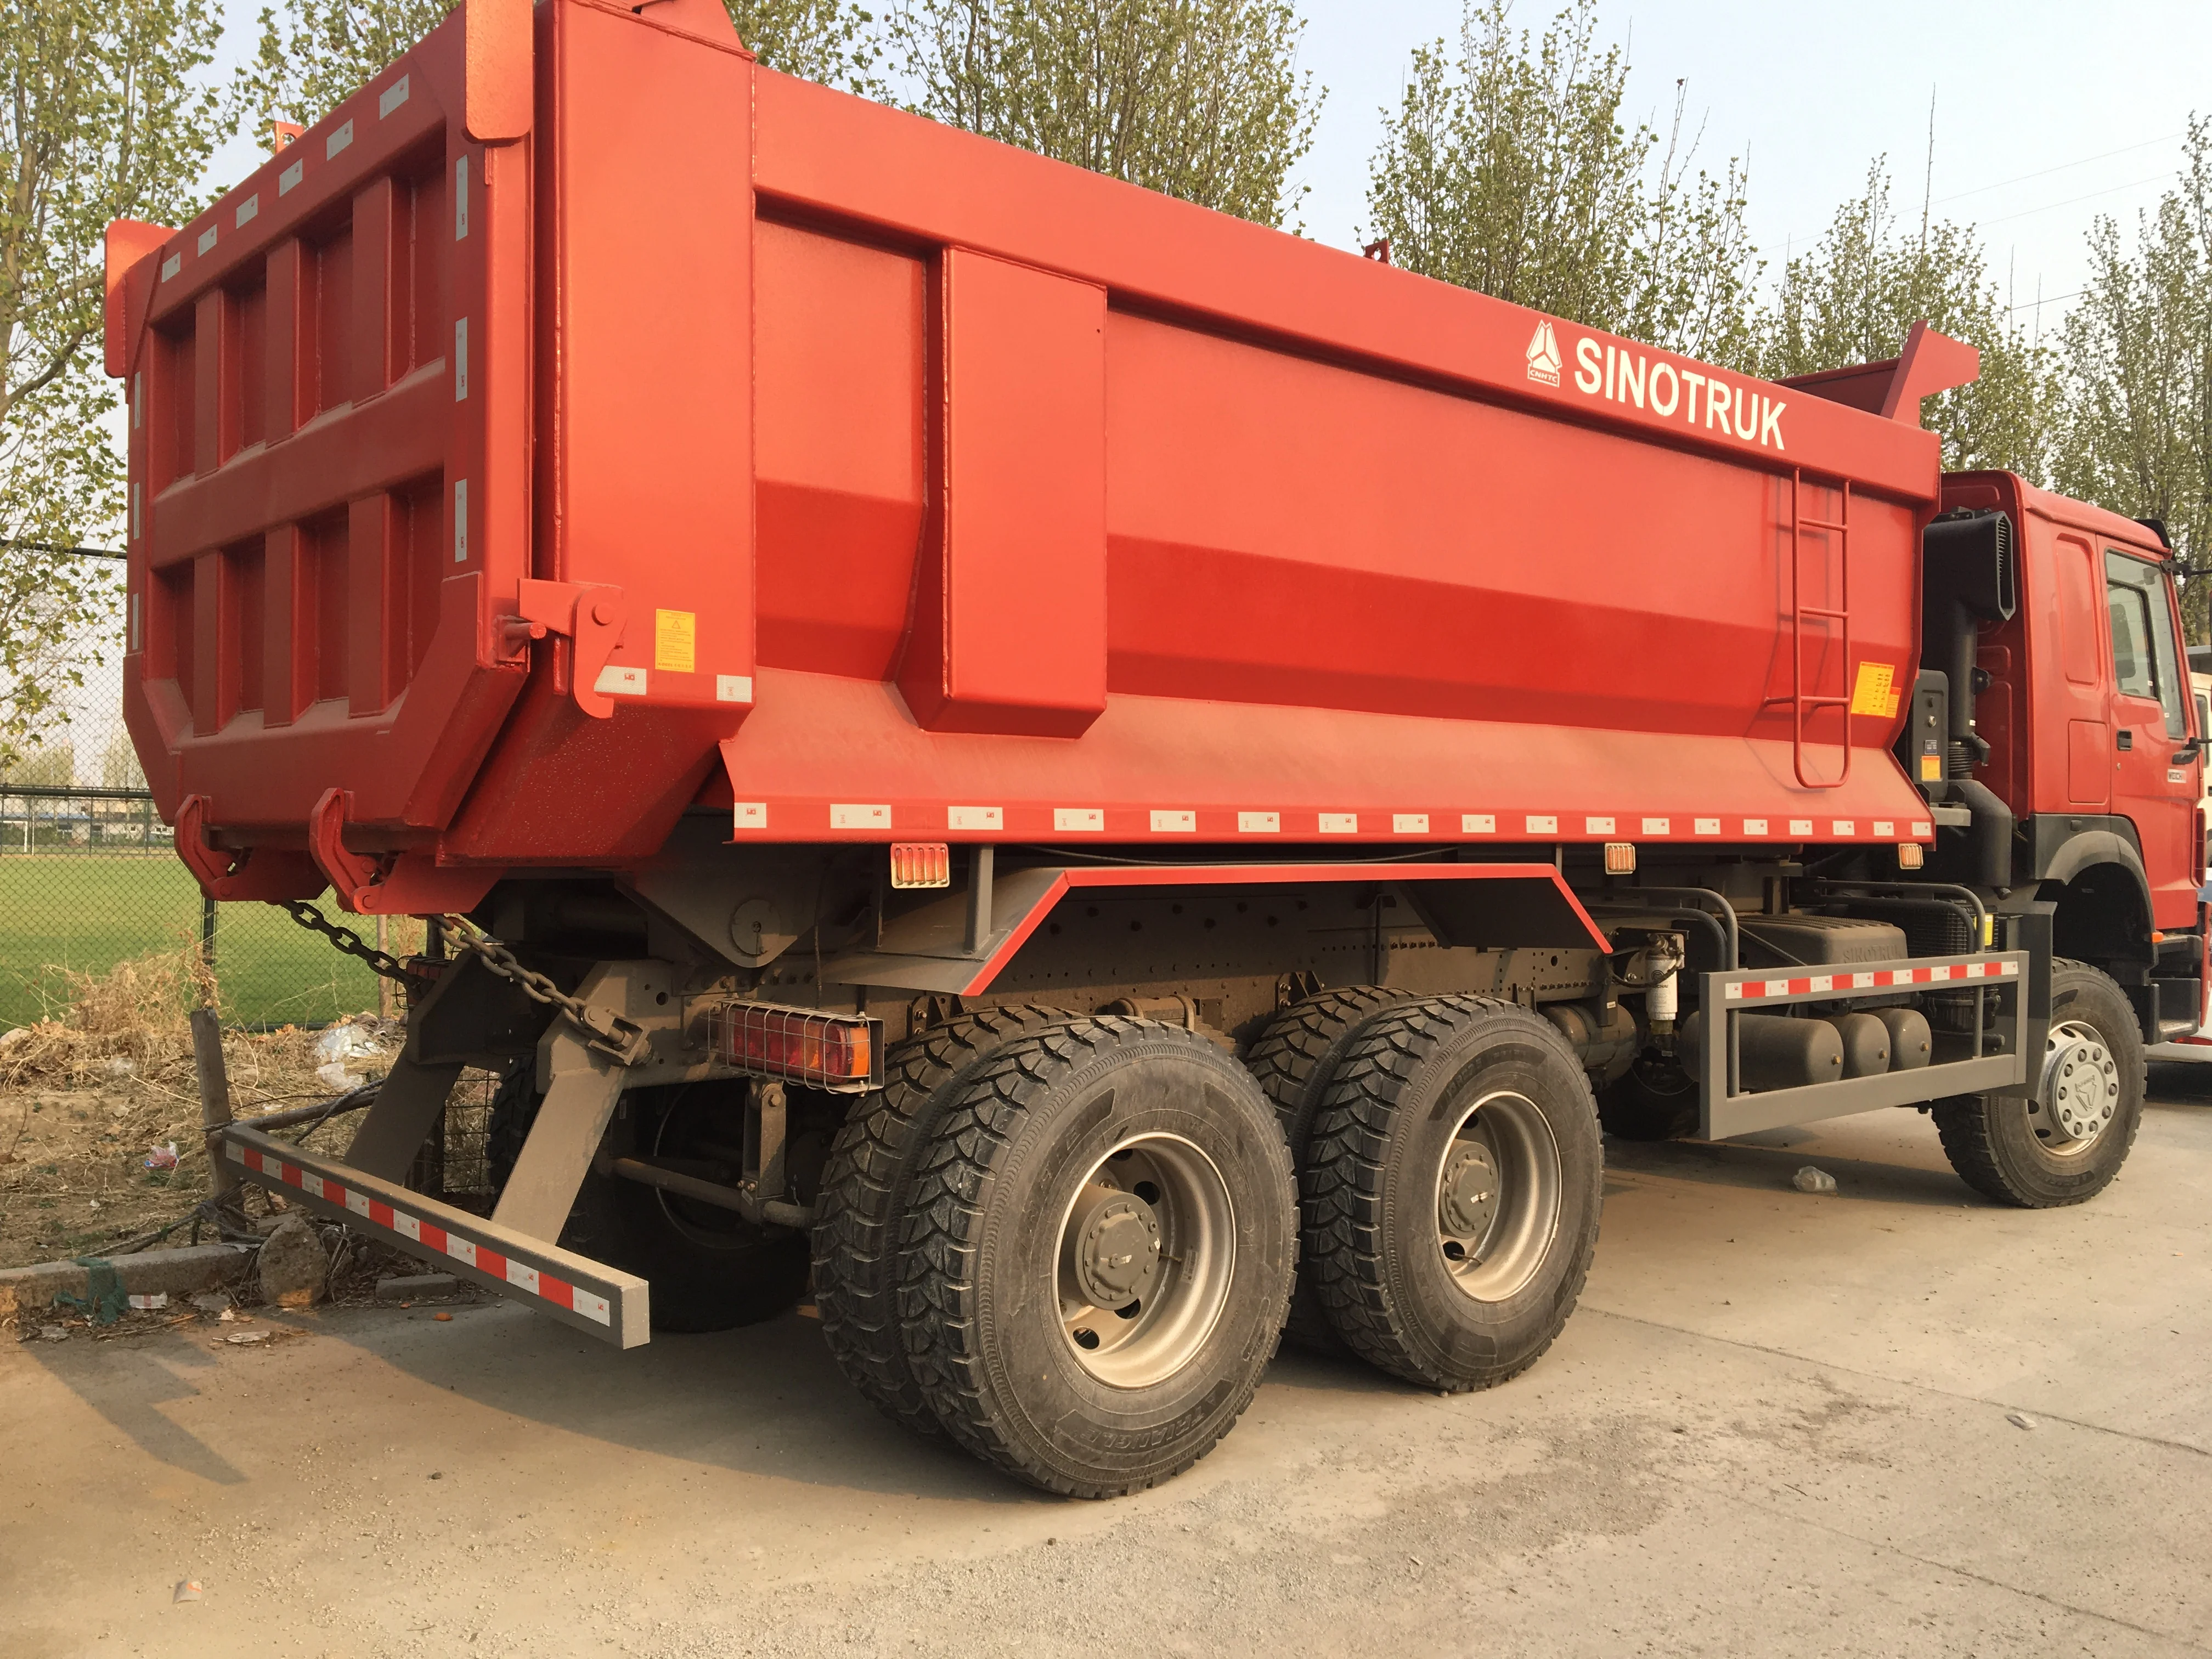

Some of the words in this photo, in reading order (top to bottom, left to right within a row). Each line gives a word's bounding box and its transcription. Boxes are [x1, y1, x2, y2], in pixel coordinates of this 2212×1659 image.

[1530, 369, 1558, 383] CNHTC
[1575, 337, 1787, 450] SINOTRUK
[1080, 1406, 1205, 1449] TRIANGLE
